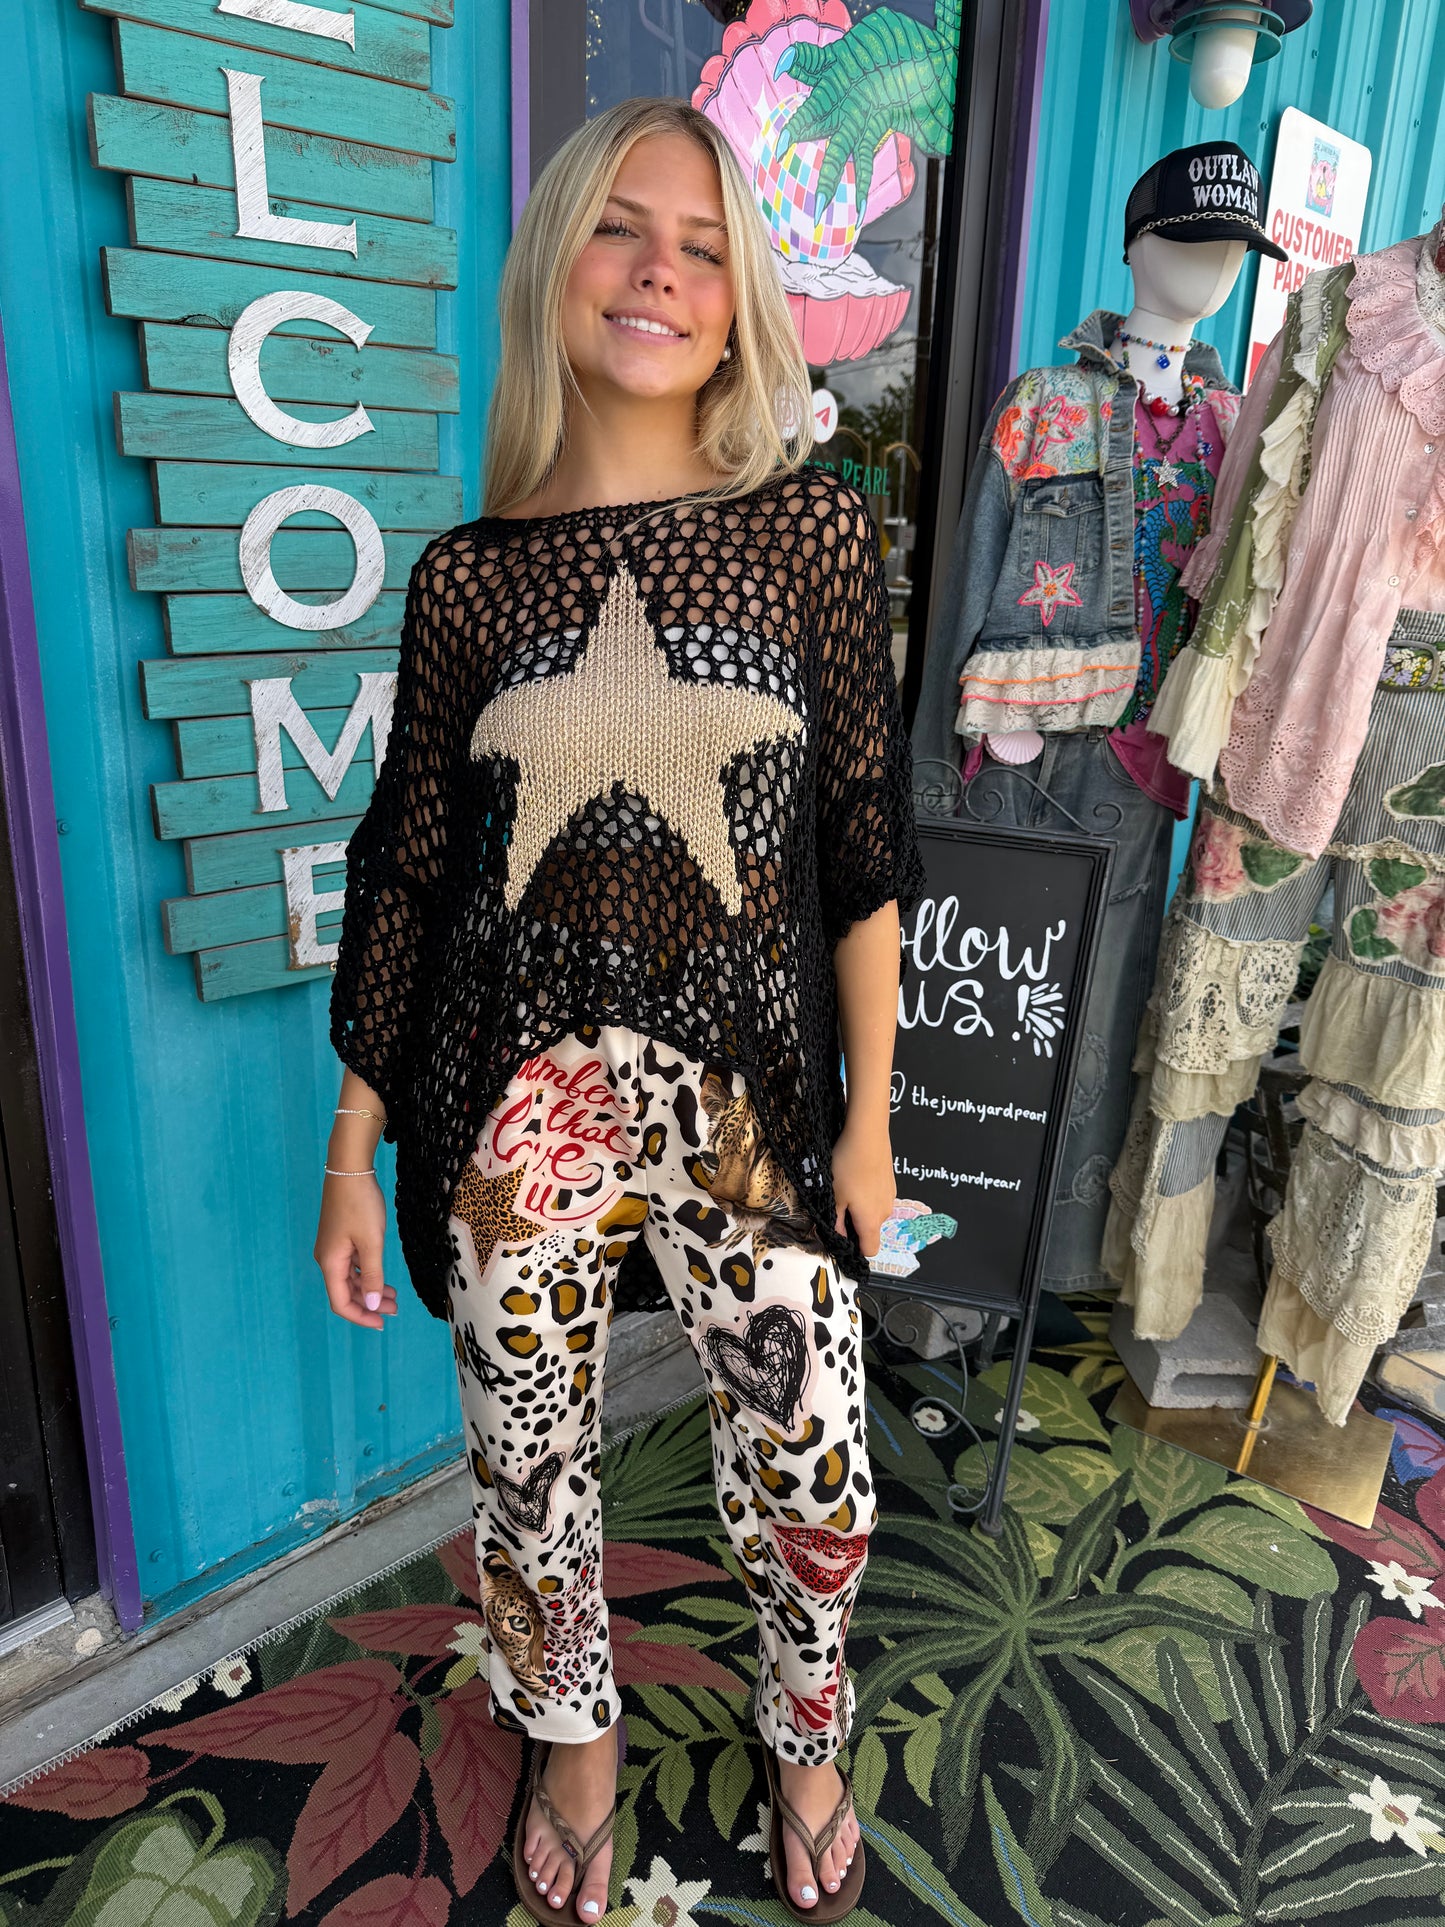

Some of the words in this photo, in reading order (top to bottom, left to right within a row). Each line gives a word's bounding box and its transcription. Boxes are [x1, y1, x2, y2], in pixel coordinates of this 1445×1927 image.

[1188, 154, 1258, 192] OUTLAW
[1192, 184, 1258, 218] WOMAN
[1271, 208, 1353, 266] CUSTOMER
[216, 0, 398, 971] LCOME
[842, 458, 891, 496] PEARL
[899, 895, 1066, 980] llow
[548, 1099, 633, 1156] that
